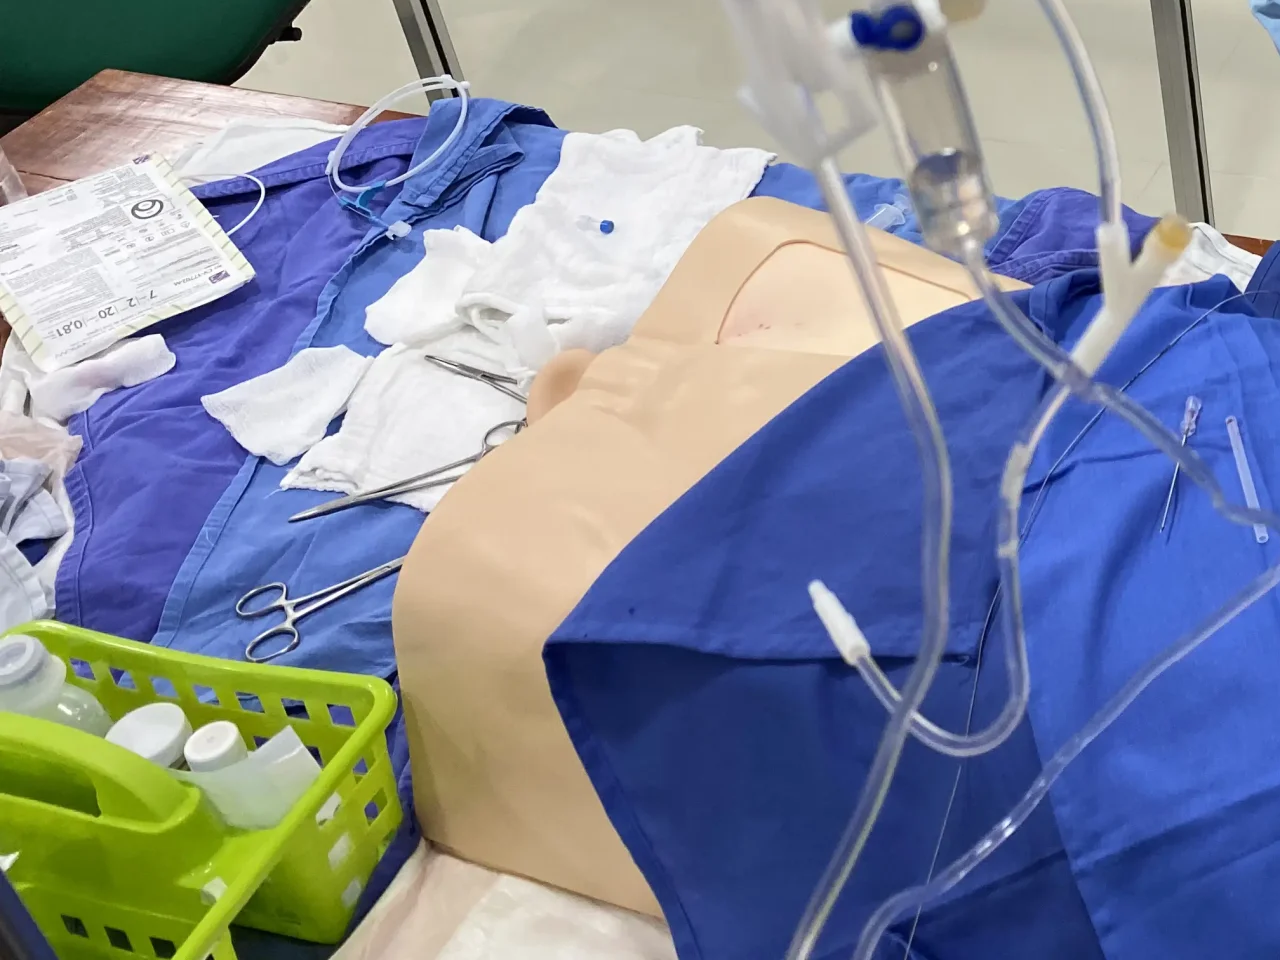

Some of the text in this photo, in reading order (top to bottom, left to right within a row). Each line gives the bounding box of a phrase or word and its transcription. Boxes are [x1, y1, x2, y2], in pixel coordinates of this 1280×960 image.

[149, 289, 158, 299] 7
[126, 297, 137, 308] 2
[98, 306, 115, 319] 20
[56, 320, 83, 337] 0,81
